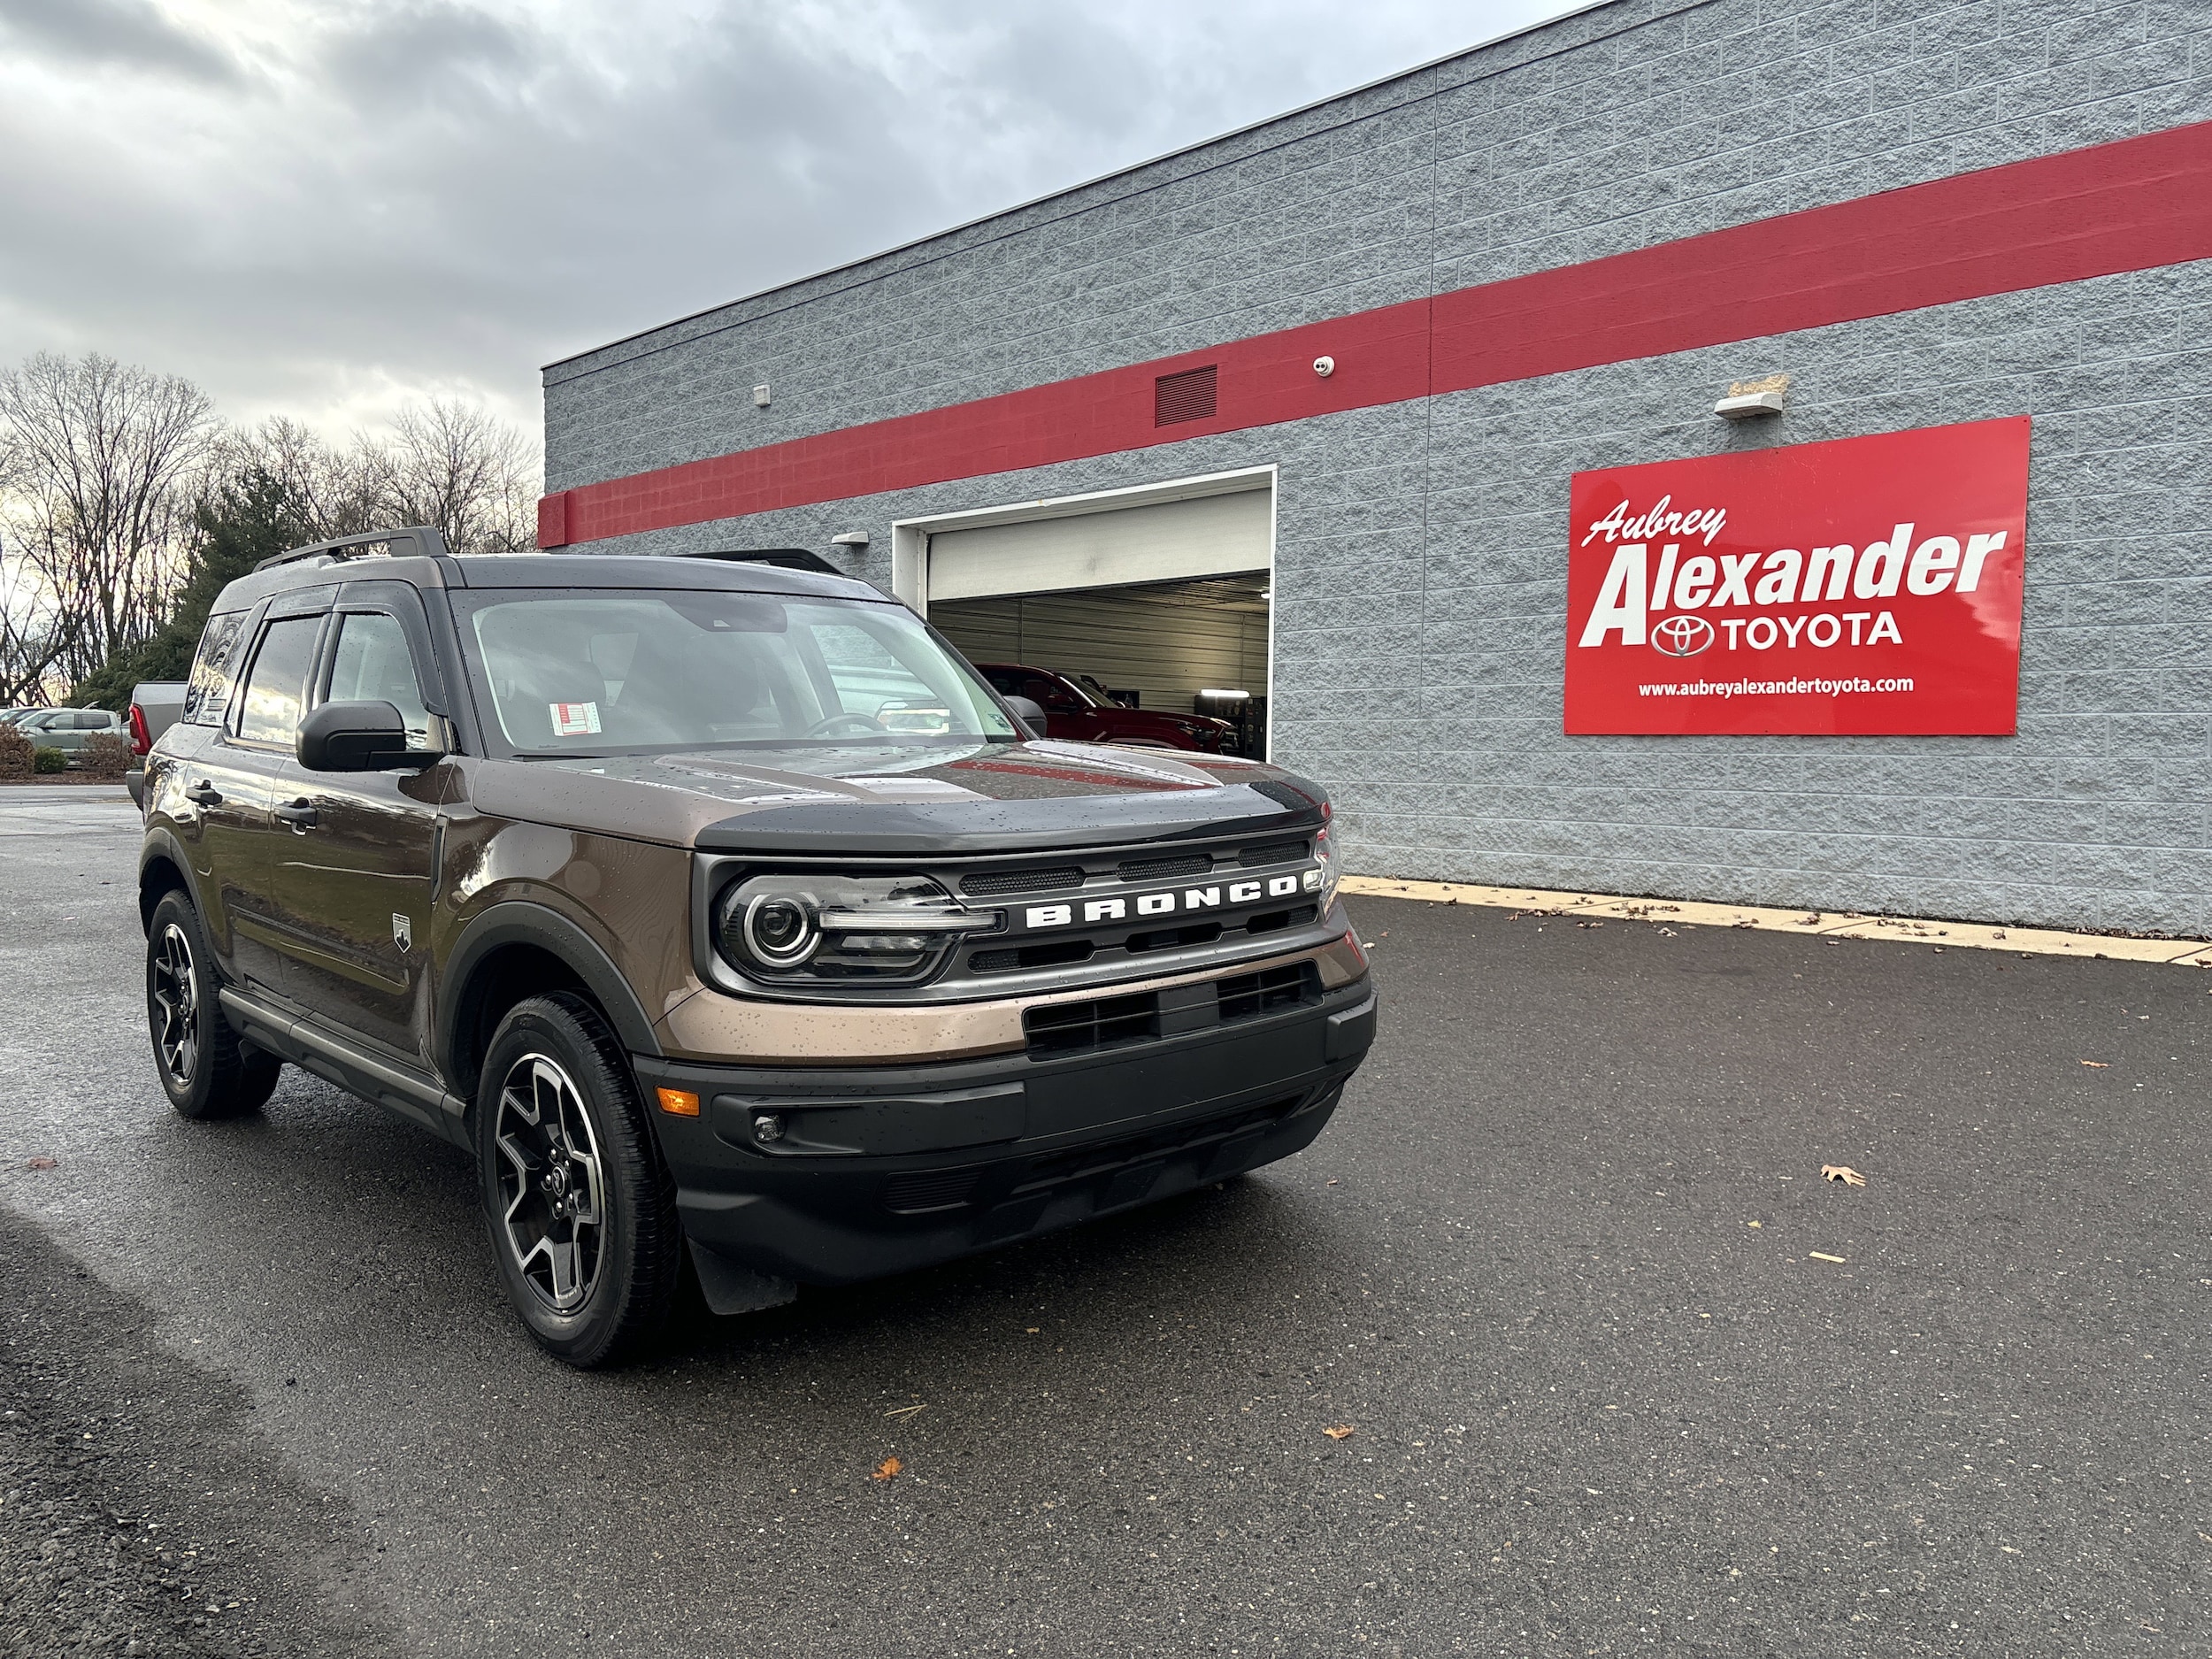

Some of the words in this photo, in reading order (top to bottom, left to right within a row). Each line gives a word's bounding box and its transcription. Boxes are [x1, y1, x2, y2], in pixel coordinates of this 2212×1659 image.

[1580, 494, 1727, 548] Aubrey
[1578, 522, 2008, 648] Alexander
[1720, 611, 1903, 651] TOYOTA
[1638, 675, 1915, 700] www.aubreyalexandertoyota.com
[1025, 875, 1298, 929] BRONCO
